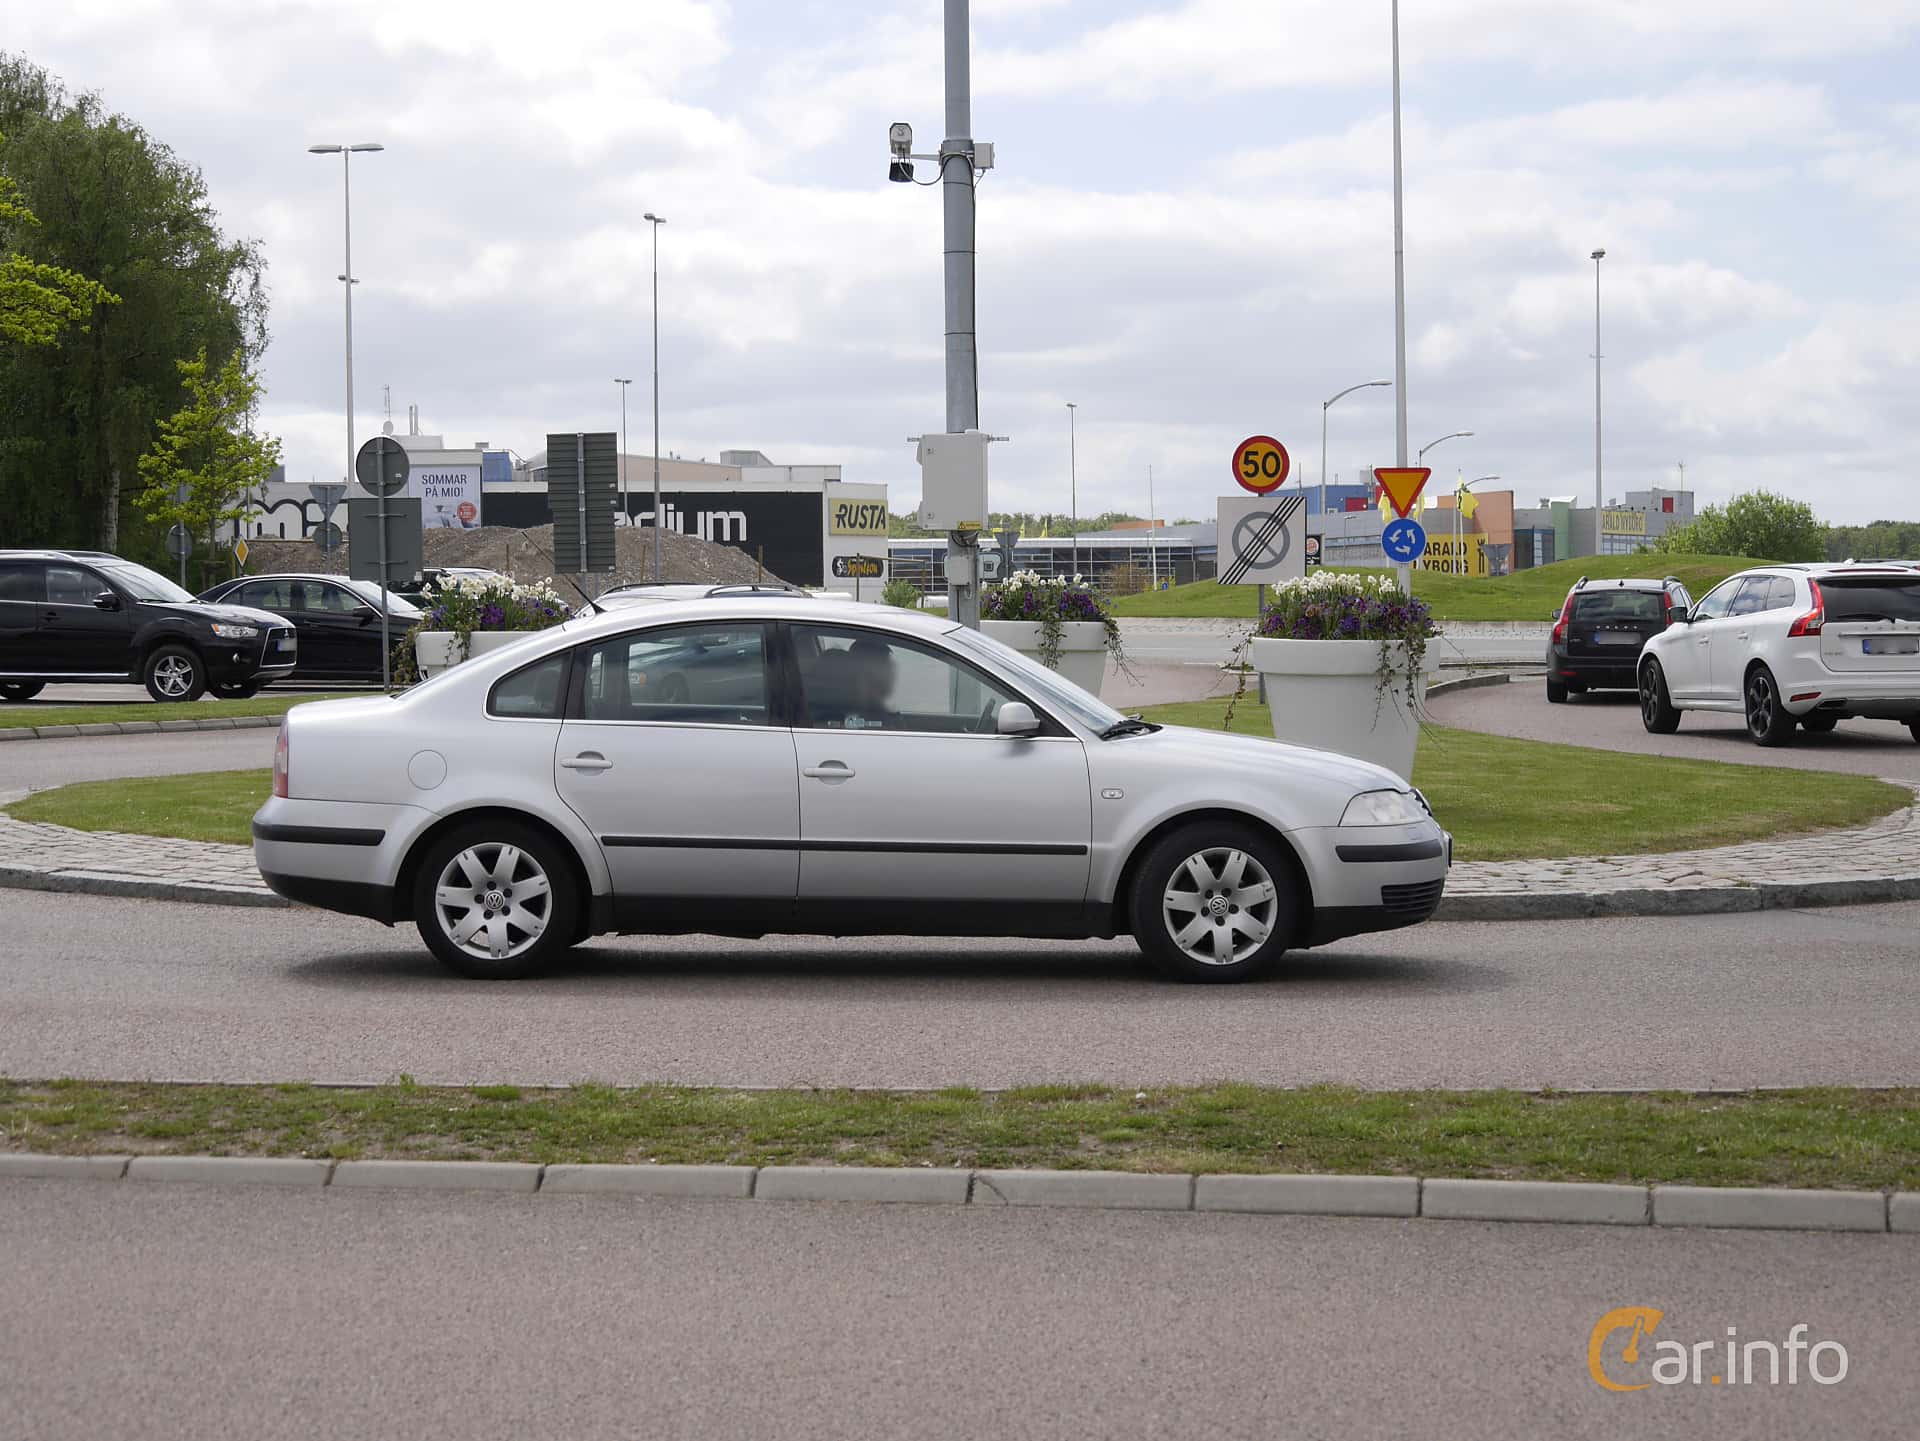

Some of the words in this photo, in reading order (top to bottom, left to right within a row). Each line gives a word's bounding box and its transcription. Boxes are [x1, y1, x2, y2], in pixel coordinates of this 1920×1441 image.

[1243, 451, 1281, 479] 50
[422, 474, 467, 485] SOMMAR
[425, 485, 439, 497] PÅ
[441, 486, 464, 497] MIO!
[613, 503, 747, 542] adium
[835, 504, 887, 530] RUSTA
[1423, 541, 1468, 556] ARALD
[1412, 559, 1469, 574] YBORG
